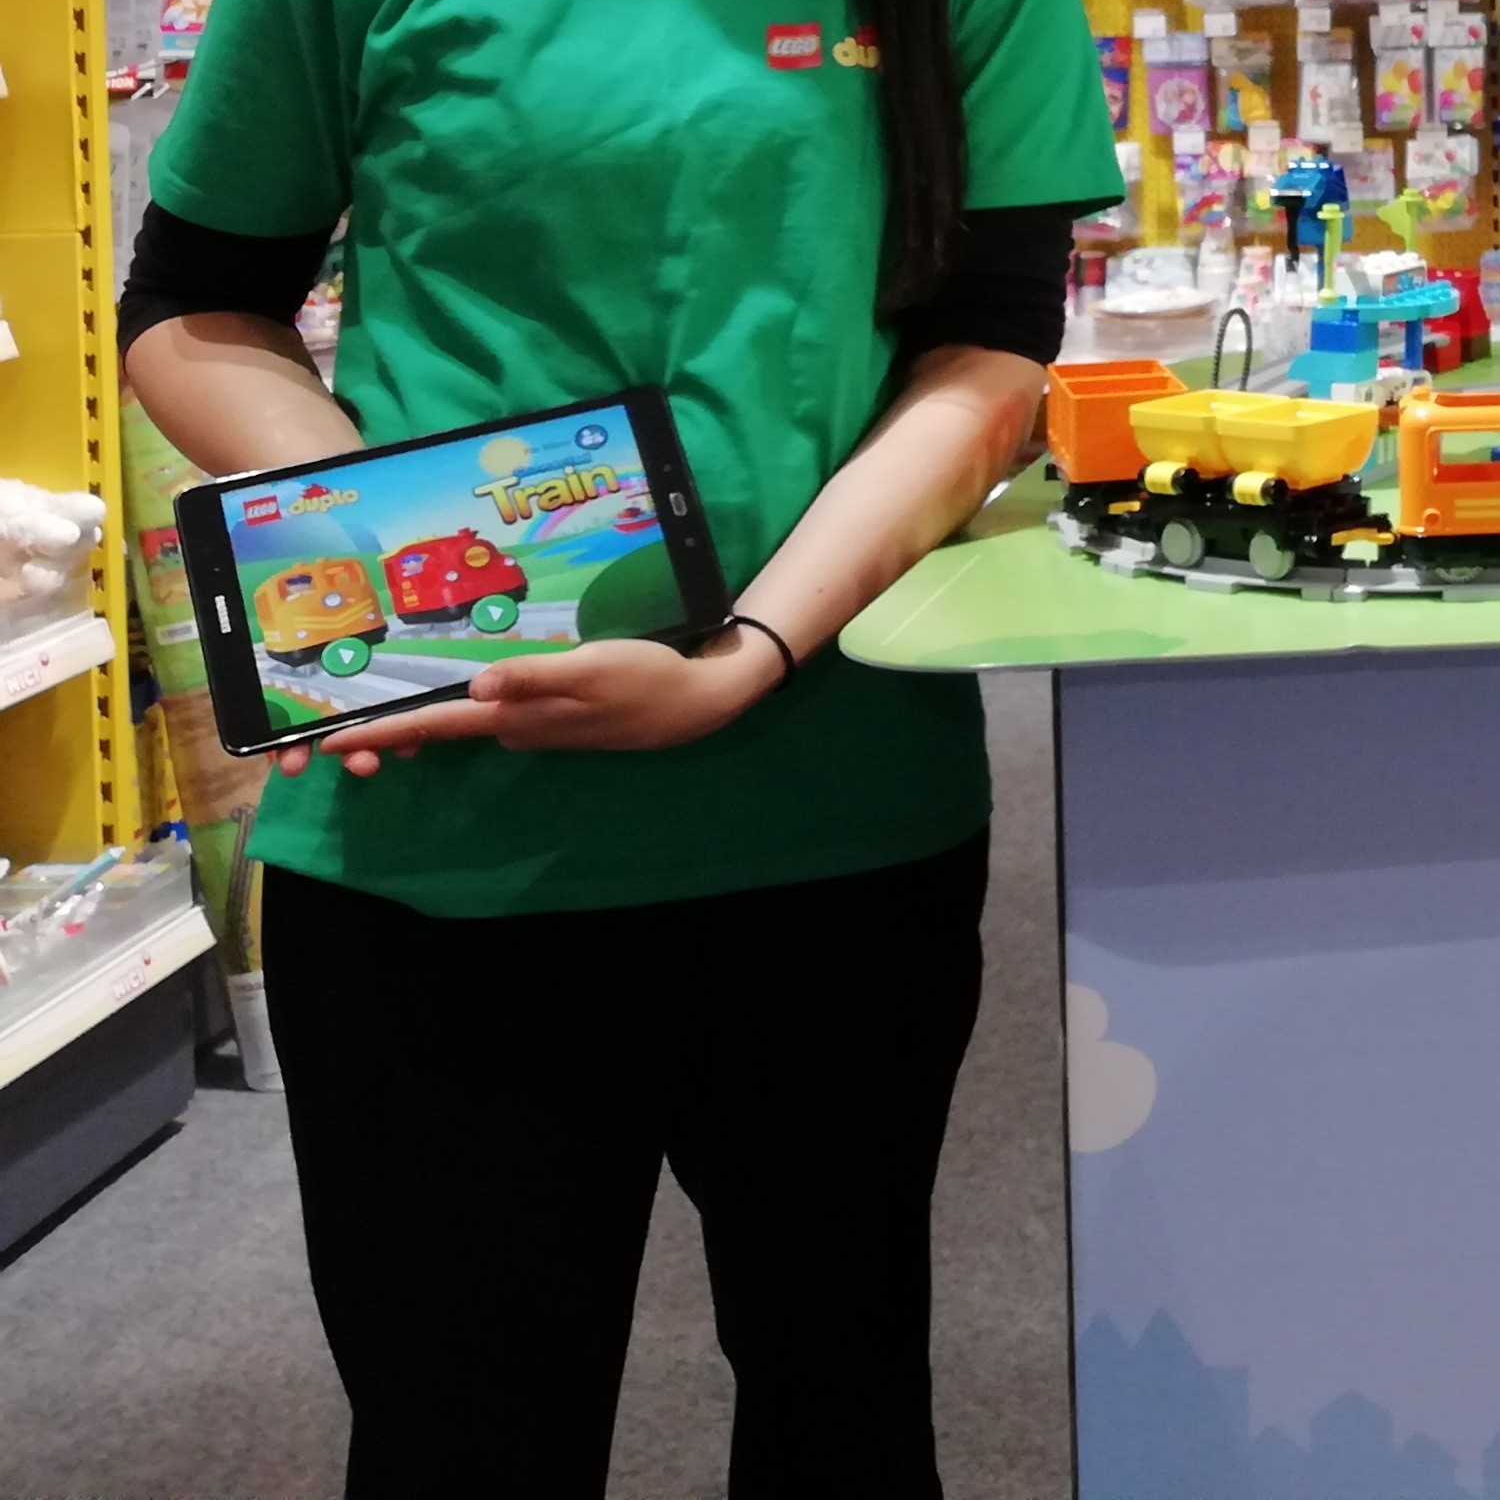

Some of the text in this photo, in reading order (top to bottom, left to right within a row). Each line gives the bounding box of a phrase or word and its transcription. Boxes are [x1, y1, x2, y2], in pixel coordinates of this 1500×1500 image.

[769, 36, 819, 57] LEGO
[287, 489, 359, 515] duplo
[473, 465, 620, 525] Train
[5, 665, 42, 696] NICI
[112, 967, 146, 1000] NICI
